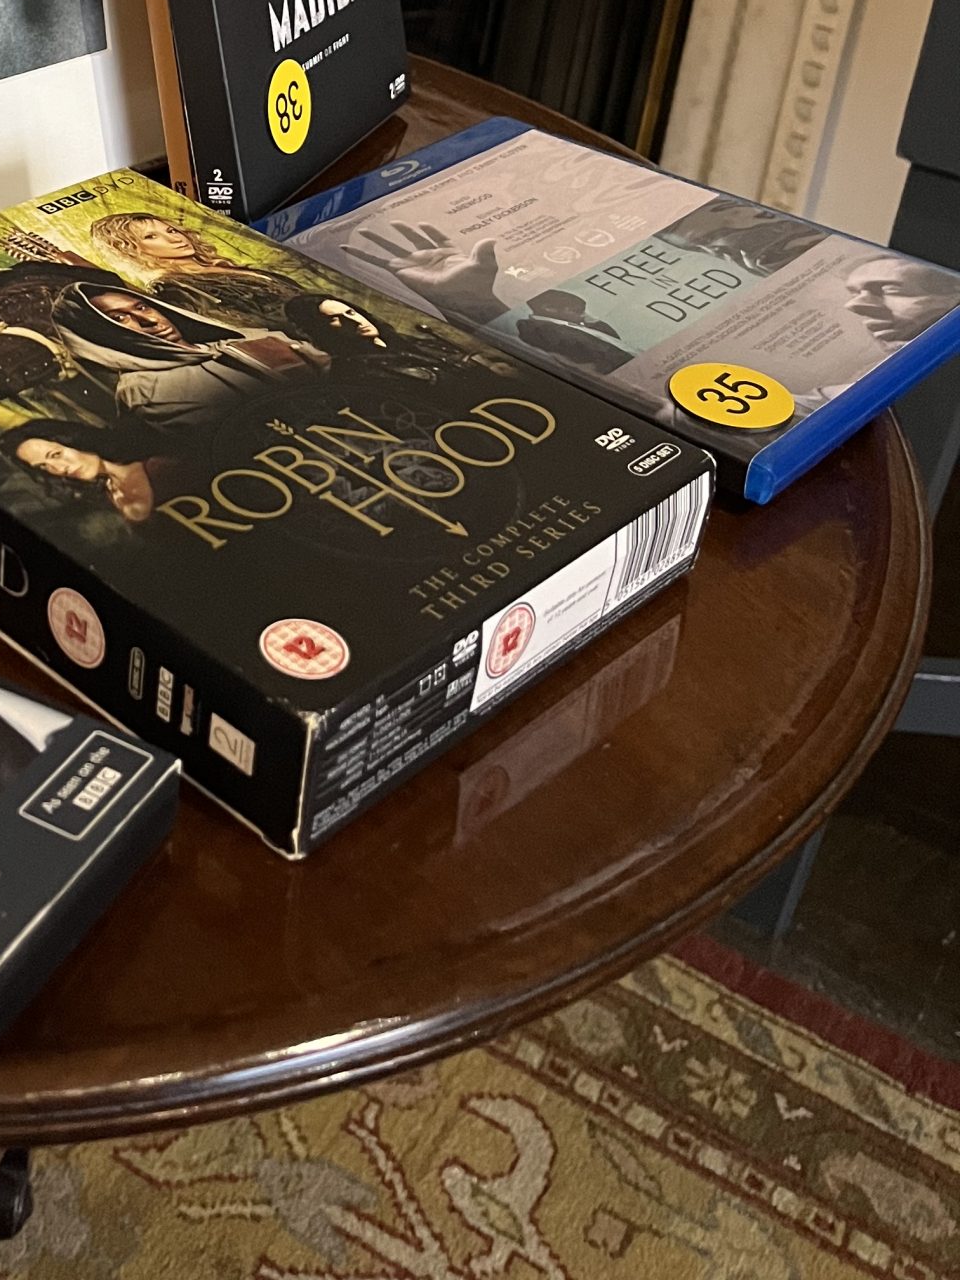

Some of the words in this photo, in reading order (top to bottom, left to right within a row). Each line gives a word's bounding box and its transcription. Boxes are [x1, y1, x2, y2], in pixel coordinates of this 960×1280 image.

[276, 81, 302, 133] 38
[38, 190, 96, 213] BBC
[93, 172, 134, 194] DVD
[208, 186, 233, 195] DVD
[213, 168, 223, 182] 2
[585, 245, 681, 296] FREE
[650, 274, 679, 290] IN
[645, 269, 742, 323] DEED
[696, 372, 769, 415] 35
[594, 428, 623, 447] DVD
[633, 465, 643, 473] 5
[638, 454, 660, 469] DISC
[656, 445, 674, 458] SET
[156, 407, 402, 550] ROBIN
[319, 398, 555, 537] HOOD
[409, 565, 459, 600] THE
[463, 493, 572, 567] COMPLETE
[419, 560, 509, 621] THIRD
[519, 500, 602, 560] SERIES
[65, 610, 87, 643] 12
[283, 635, 326, 659] 12
[453, 630, 479, 655] DVD
[502, 626, 521, 656] 12
[157, 666, 173, 722] BBC
[41, 798, 61, 814] As
[57, 775, 82, 800] seen
[78, 762, 95, 778] on
[89, 746, 111, 764] the
[73, 766, 121, 810] BBC
